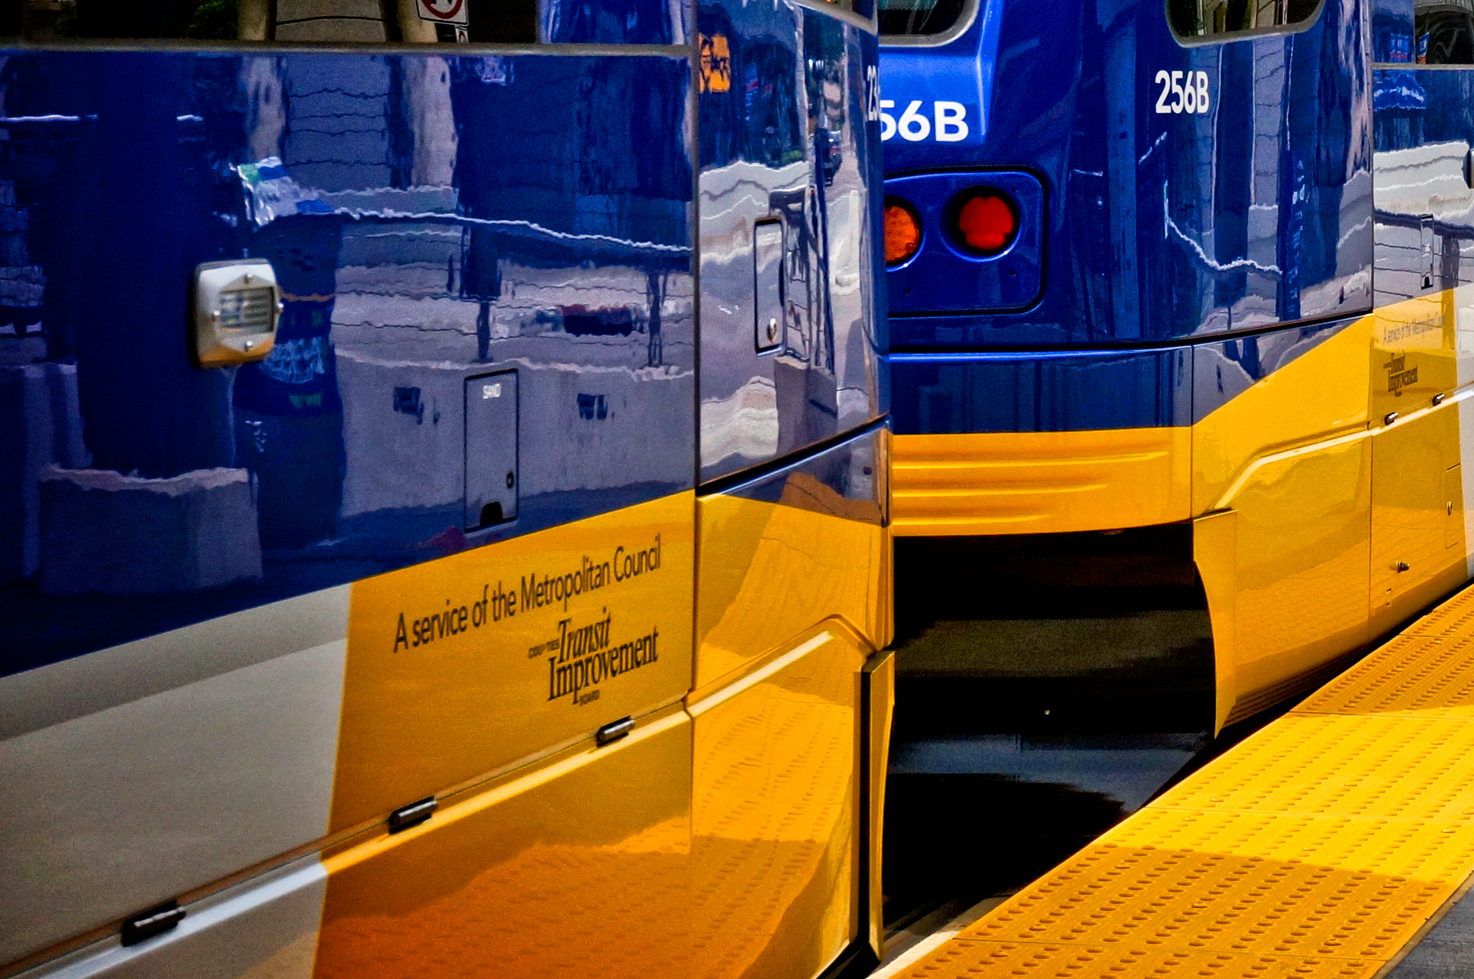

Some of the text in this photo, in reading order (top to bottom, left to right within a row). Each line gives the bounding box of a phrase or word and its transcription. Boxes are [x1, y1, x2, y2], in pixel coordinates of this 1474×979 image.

[1154, 70, 1210, 115] 256B
[393, 532, 661, 653] A service of the Metropolitan Council
[547, 625, 659, 705] Improvement
[557, 606, 612, 664] Transit
